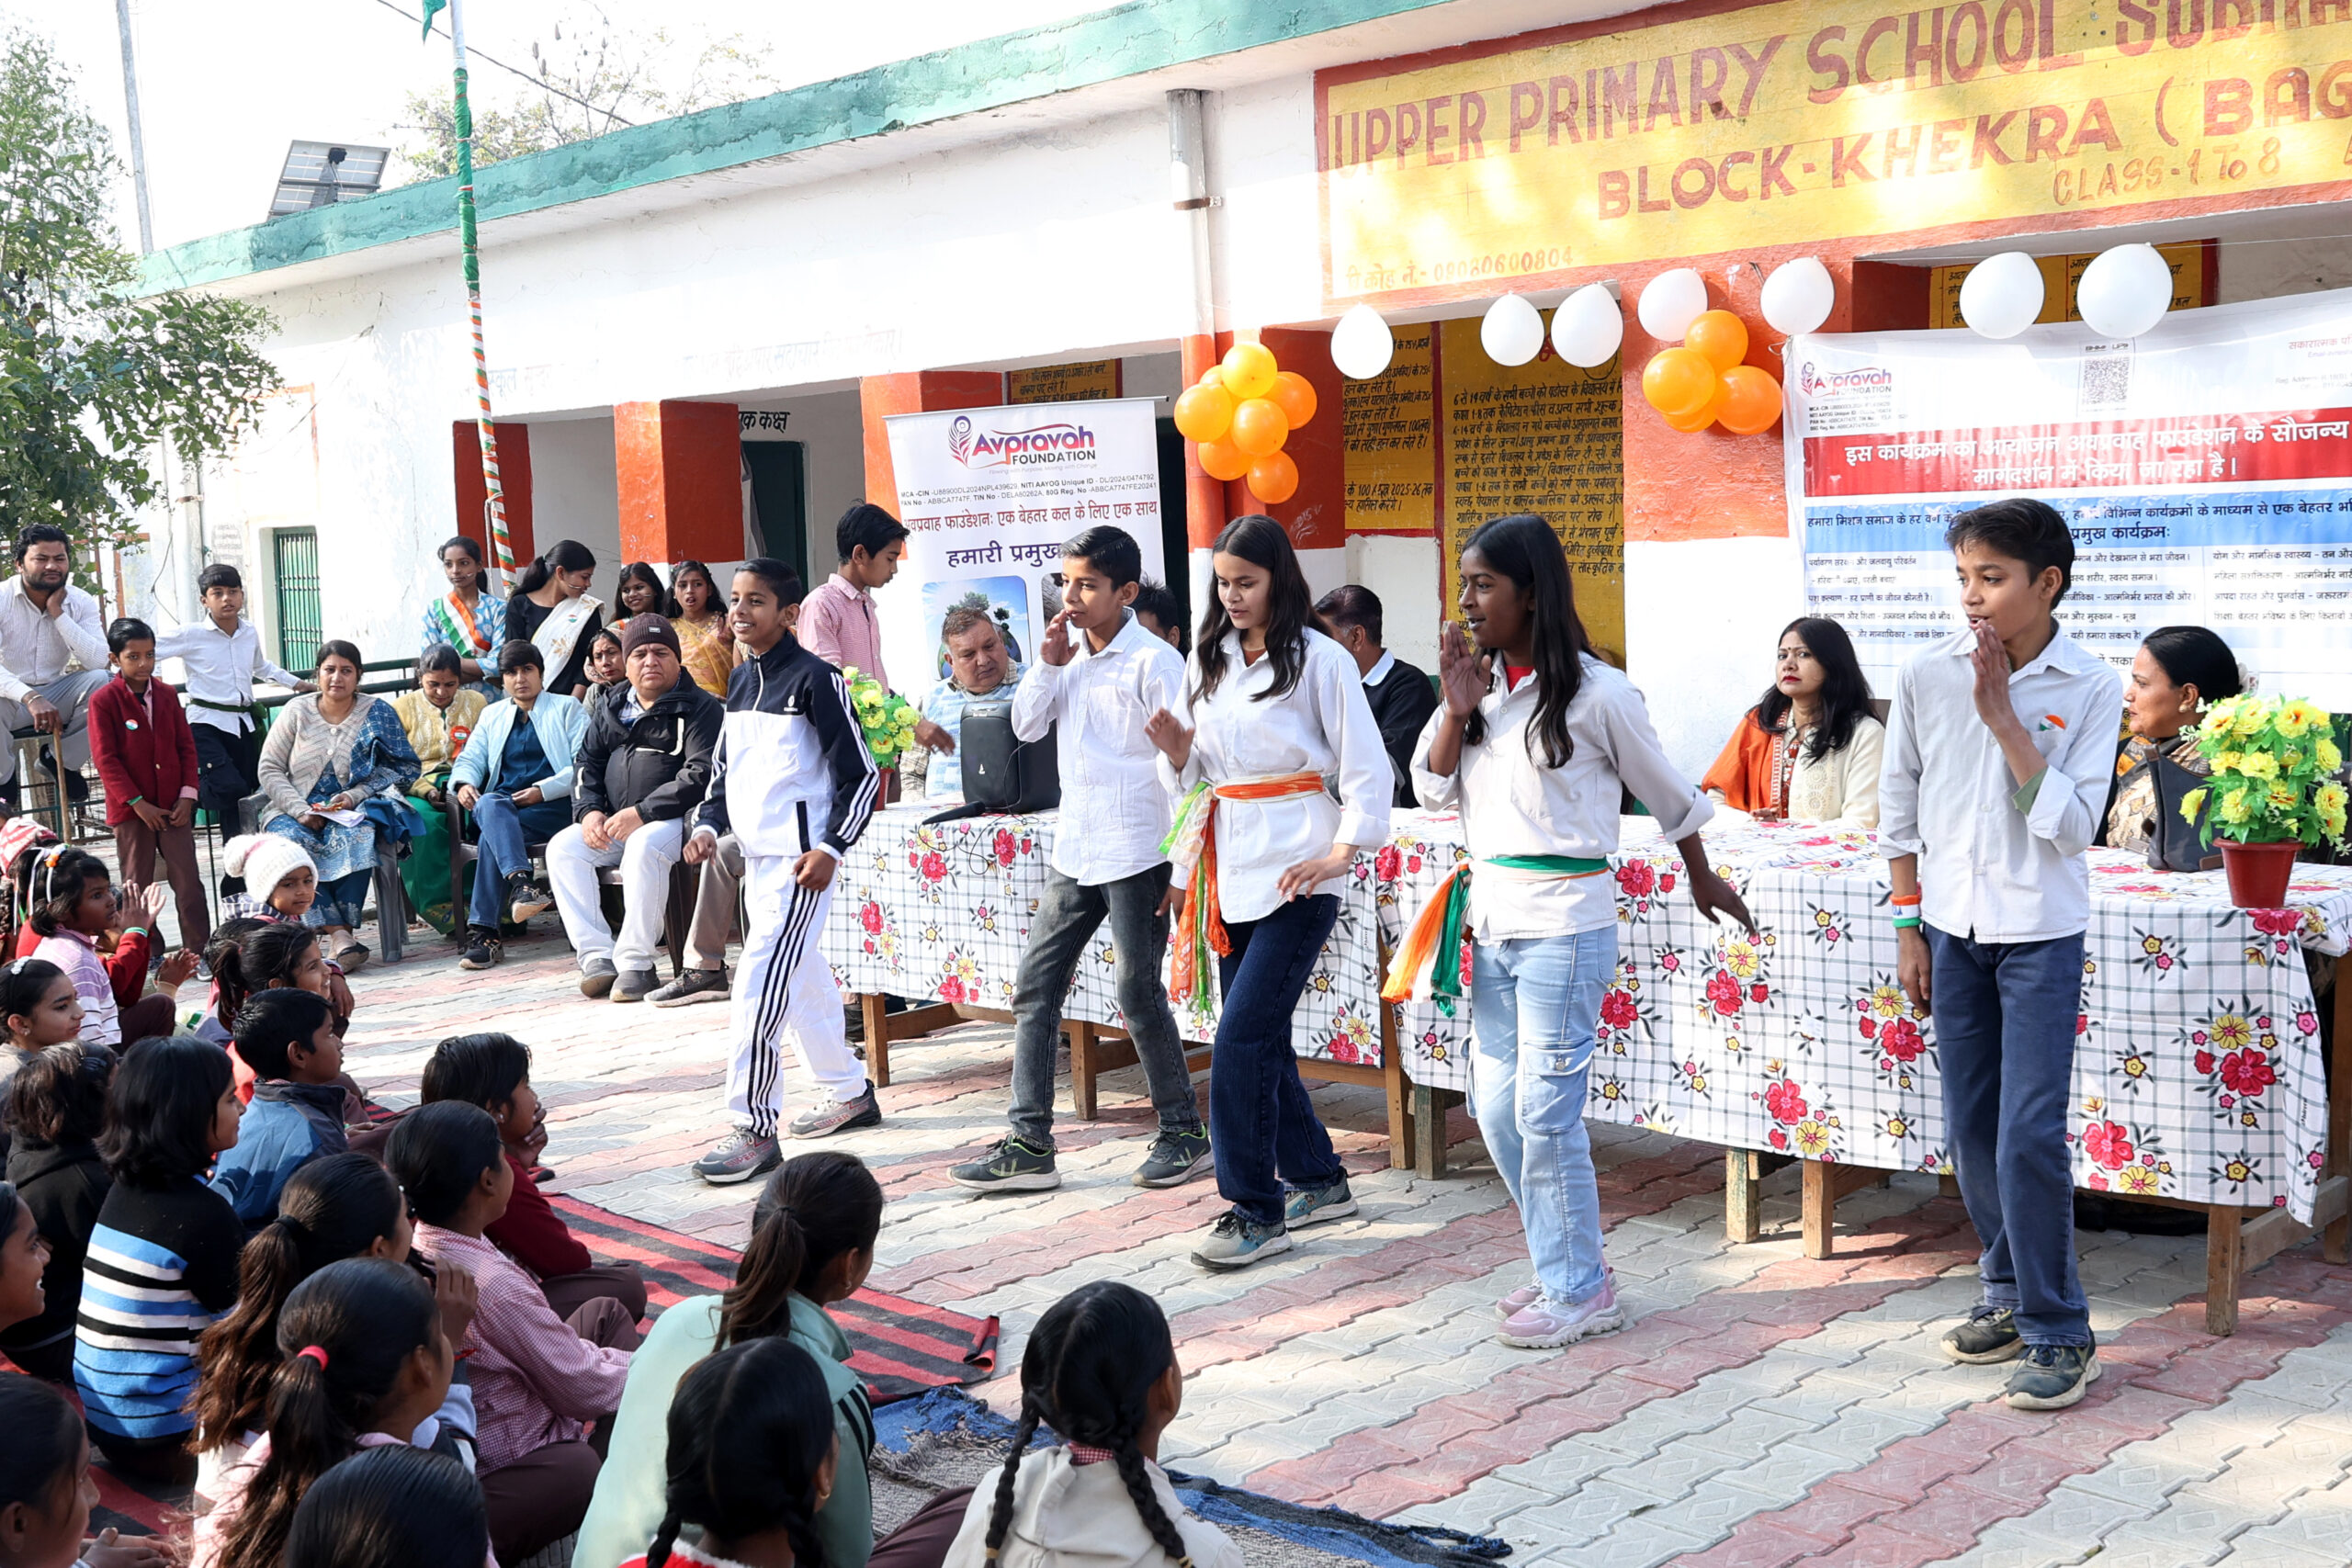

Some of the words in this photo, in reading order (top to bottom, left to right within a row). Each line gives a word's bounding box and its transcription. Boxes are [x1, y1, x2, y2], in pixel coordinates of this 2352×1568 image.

[1334, 91, 1486, 179] UPPER
[1510, 35, 1786, 152] PRIMARY
[1806, 0, 2083, 105] SCHOOL
[2258, 137, 2281, 175] 8
[2289, 337, 2338, 349] सकारात्मक
[1494, 386, 1503, 402] के
[1503, 383, 1518, 402] सभी
[1537, 381, 1547, 400] को
[1571, 379, 1578, 397] के
[1576, 398, 1594, 413] सभी
[759, 412, 790, 433] कक्ष
[972, 425, 1095, 463] Avpravah
[1845, 446, 1872, 467] इस
[1878, 436, 1948, 461] कार्यक्रम
[1953, 440, 1976, 457] का
[1980, 432, 2060, 456] आयोजन
[2068, 431, 2146, 452] अवप्रवाह
[2154, 422, 2237, 448] फाउंडेशन
[2244, 417, 2264, 444] के
[2270, 415, 2350, 442] सौजन्य
[1012, 450, 1096, 465] FOUNDATION
[1973, 459, 2053, 484] मार्गदर्शन
[2060, 457, 2077, 482] में
[2086, 454, 2132, 481] किया
[2139, 460, 2164, 479] जा
[2172, 458, 2205, 479] रहा
[1061, 478, 1085, 486] Unique
[904, 516, 941, 532] अवप्रवाह
[997, 511, 1015, 525] एक
[1018, 504, 1047, 524] बेहतर
[1051, 506, 1070, 521] कल
[1074, 501, 1085, 521] के
[1087, 500, 1110, 520] लिए
[1114, 502, 1132, 520] एक
[1135, 501, 1158, 515] साथ
[1569, 511, 1584, 523] पर
[1587, 509, 1602, 523] रोक
[1807, 517, 1833, 527] हमारा
[1865, 515, 1894, 525] समाज
[1896, 511, 1906, 525] के
[1909, 514, 1921, 525] हर
[2104, 505, 2142, 519] विभिन्न
[2146, 502, 2193, 517] कार्यक्रमों
[2198, 502, 2209, 516] के
[2212, 504, 2253, 516] माध्यम
[2257, 501, 2268, 514] से
[2273, 503, 2294, 515] एक
[2298, 499, 2334, 513] बेहतर
[1604, 523, 1619, 541] पूर्ण
[2070, 527, 2106, 545] प्रमुख
[945, 540, 1002, 568] हमारी
[2094, 552, 2107, 562] और
[2109, 552, 2137, 562] देखभाल
[2140, 551, 2146, 561] से
[2213, 551, 2229, 559] योग
[2232, 550, 2245, 559] और
[2248, 548, 2281, 559] मानसिक
[2322, 550, 2335, 558] तन
[1577, 558, 1615, 576] सांस्कृतिक
[2214, 570, 2236, 580] महिला
[2294, 569, 2335, 580] आत्मनिर्भर
[1821, 594, 1842, 603] कल्याण
[1860, 592, 1873, 602] प्राणी
[1884, 592, 1901, 602] जीवन
[1904, 592, 1923, 602] कीमती
[2104, 591, 2141, 601] आत्मनिर्भर
[2165, 591, 2175, 600] की
[2240, 592, 2256, 600] राहत
[2261, 591, 2274, 600] और
[2278, 589, 2304, 603] पुनर्वास
[1848, 610, 1859, 620] और
[1908, 610, 1927, 620] भविष्य
[2072, 611, 2085, 620] और
[2087, 613, 2112, 623] मुस्कान
[1869, 628, 1905, 637] मानवाधिकार
[1914, 628, 1930, 637] सबके
[2071, 629, 2084, 639] यही
[2109, 630, 2132, 640] संकल्प
[724, 1149, 757, 1168] SUPER
